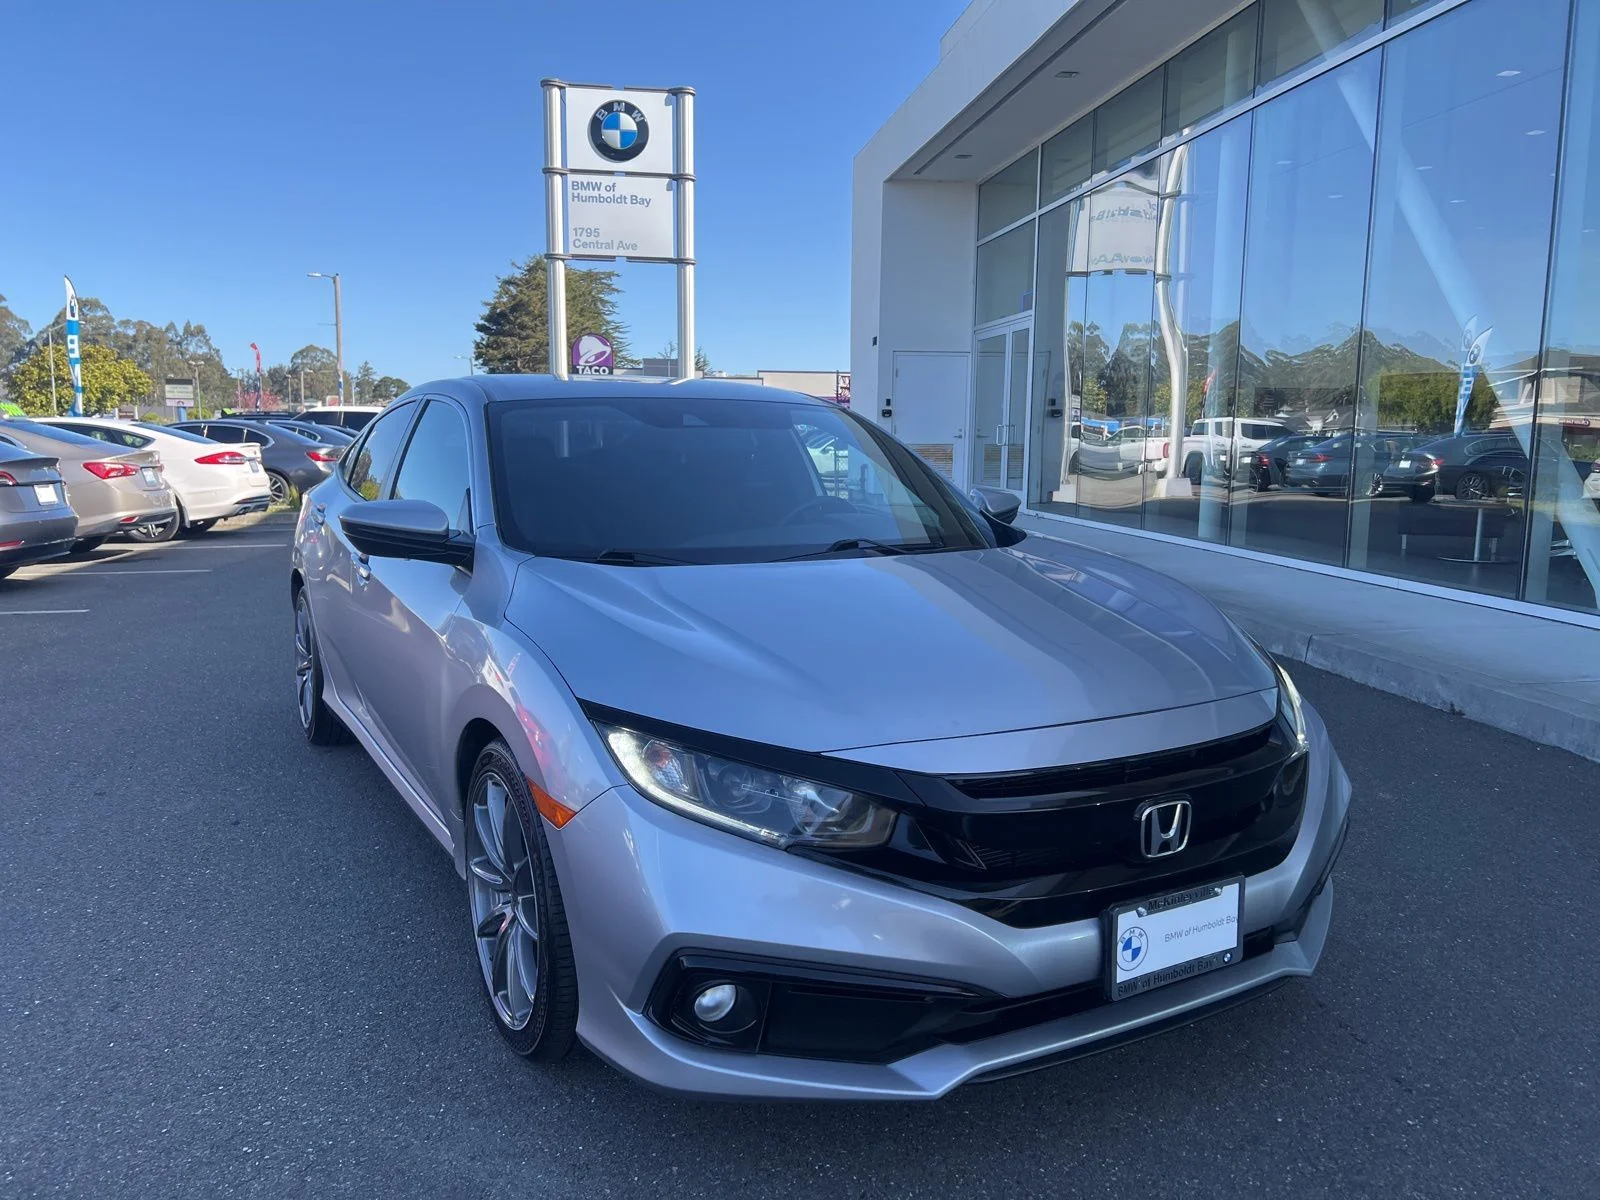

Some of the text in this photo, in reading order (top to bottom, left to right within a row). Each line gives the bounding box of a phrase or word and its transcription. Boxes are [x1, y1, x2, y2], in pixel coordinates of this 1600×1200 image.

[595, 102, 645, 122] BMW
[571, 181, 617, 193] BMW of
[571, 193, 651, 208] Humboldt Bay
[572, 227, 600, 238] 1795
[572, 239, 638, 251] Central Ave
[576, 365, 609, 375] TACO
[1164, 930, 1184, 943] BMW
[1184, 927, 1192, 937] of
[1193, 918, 1225, 934] Humboldt
[1153, 964, 1195, 985] Humboldt
